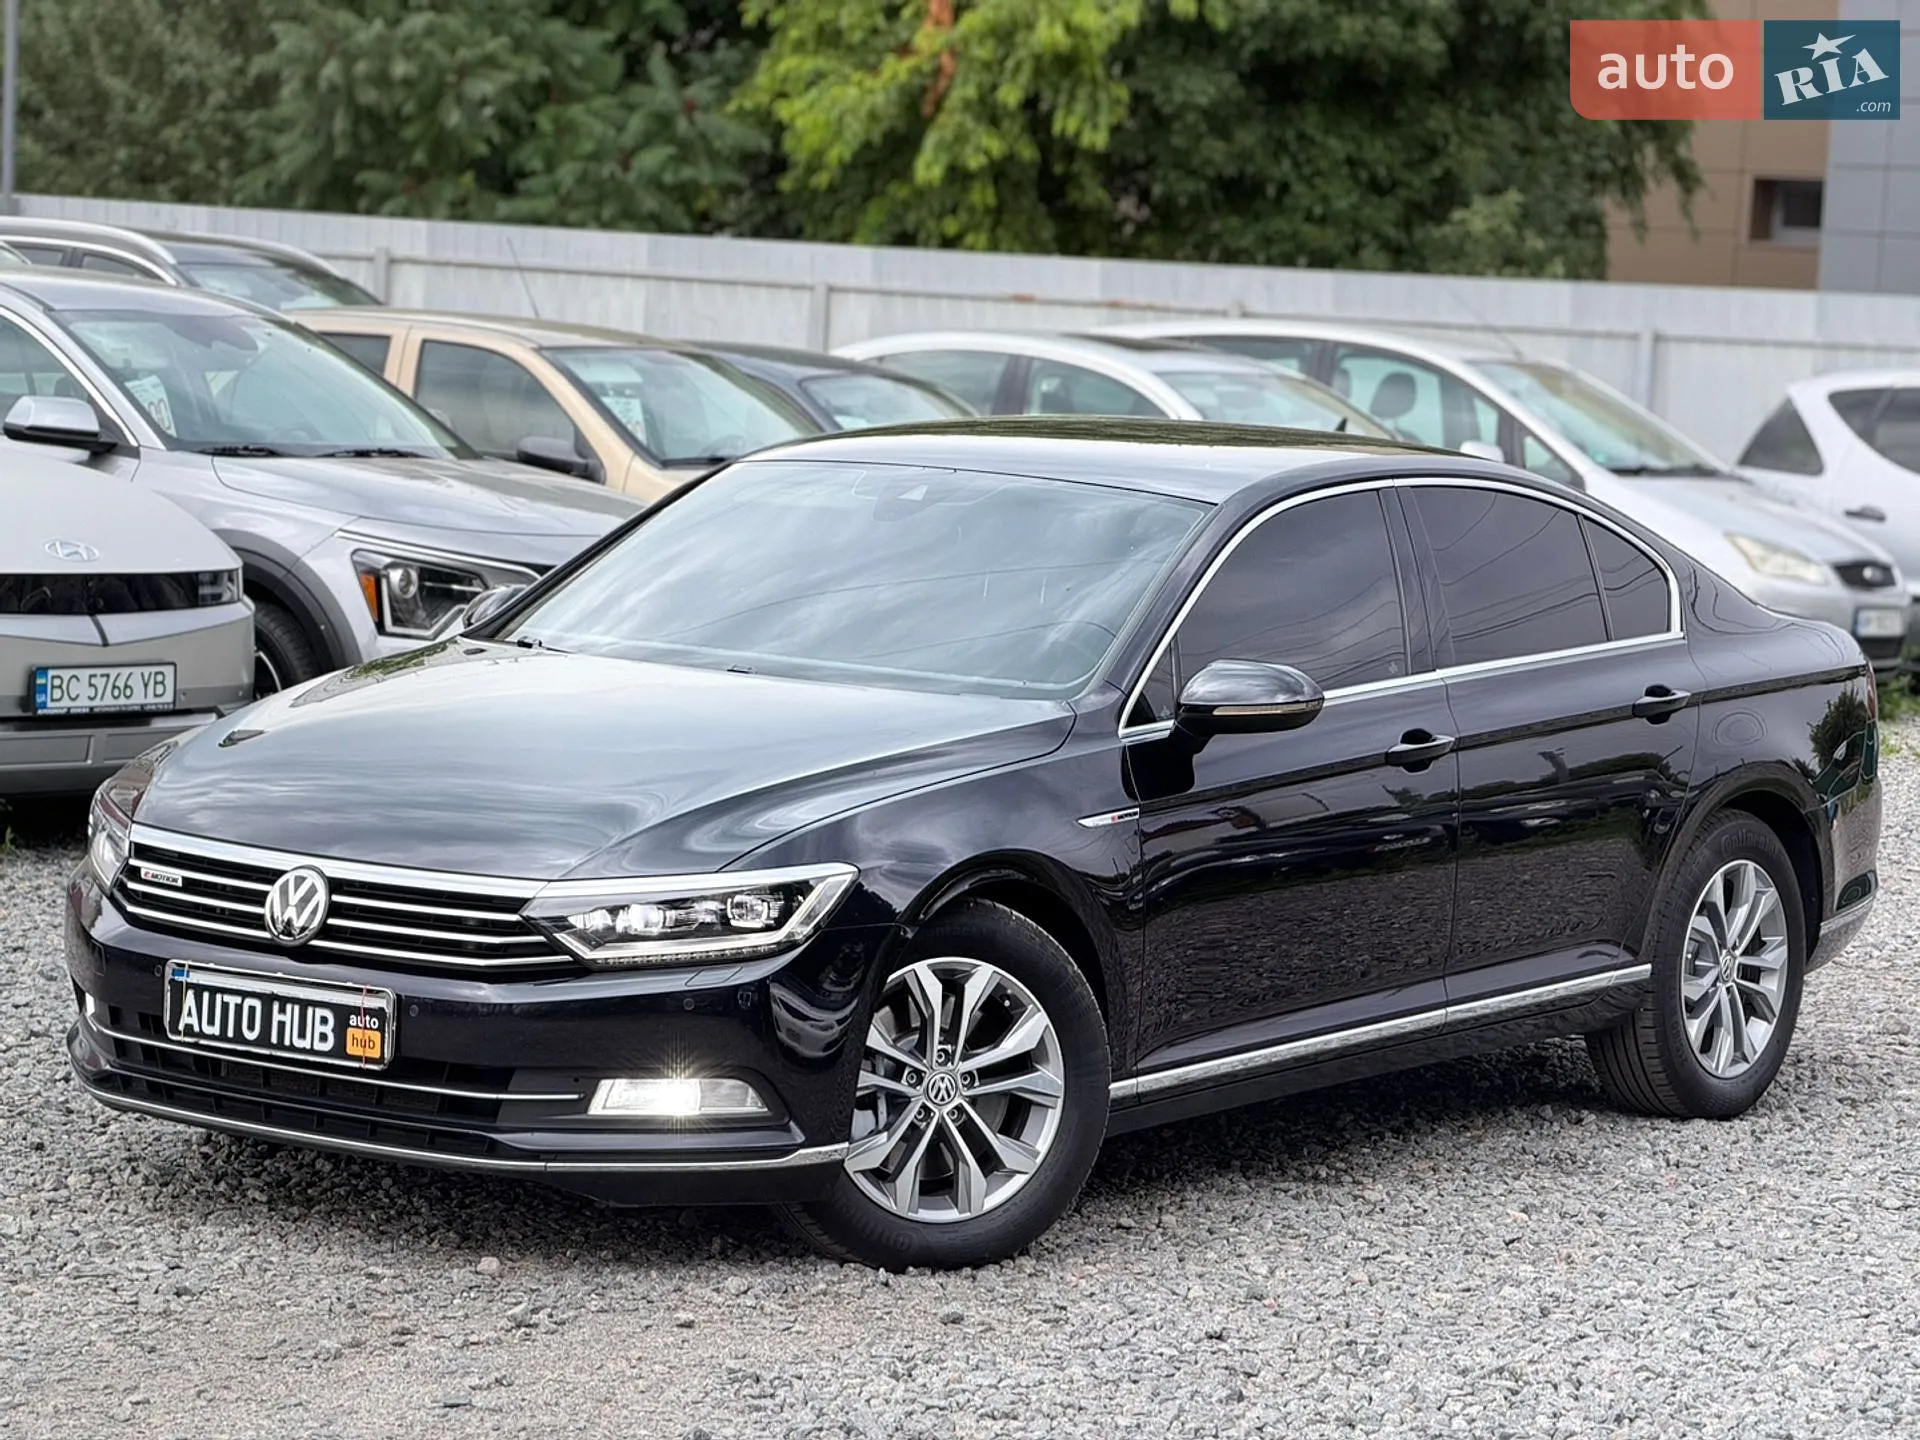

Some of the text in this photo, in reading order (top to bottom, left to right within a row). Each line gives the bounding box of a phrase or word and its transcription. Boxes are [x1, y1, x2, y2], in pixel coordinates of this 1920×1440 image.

[50, 671, 167, 702] BC 5766 YB
[178, 989, 336, 1052] AUTO HUB
[349, 1013, 379, 1030] auto
[351, 1033, 376, 1051] hub
